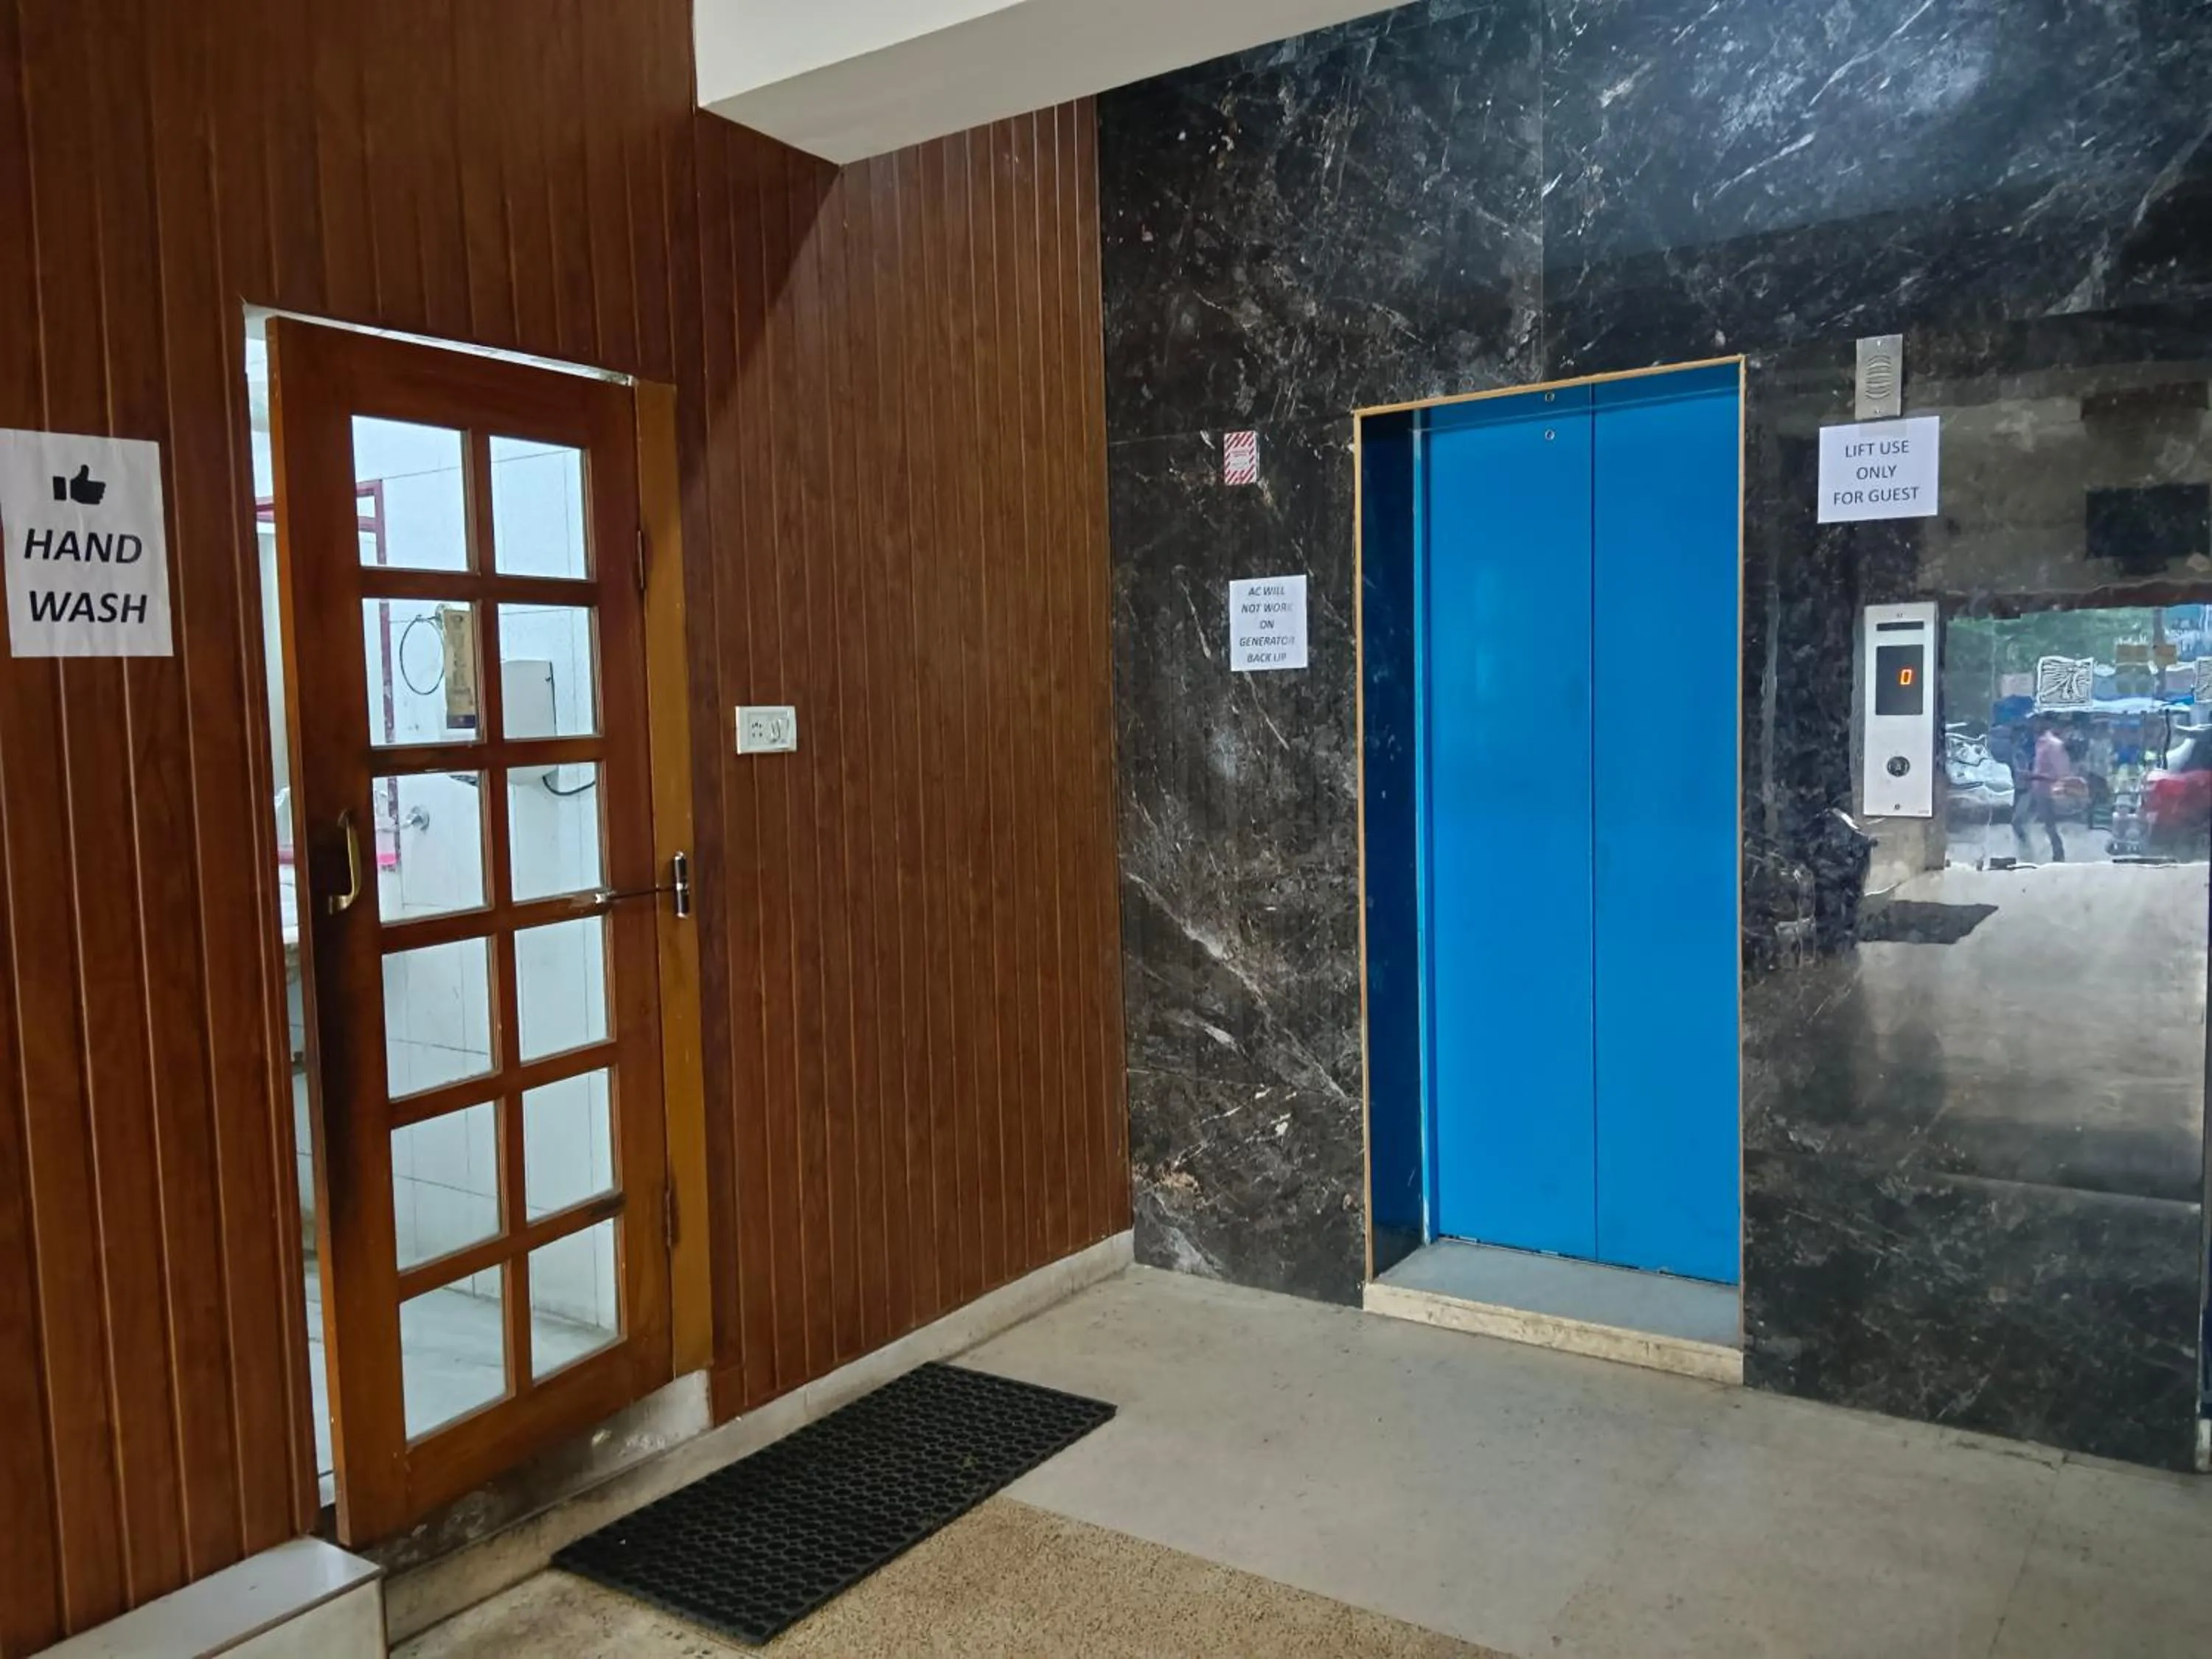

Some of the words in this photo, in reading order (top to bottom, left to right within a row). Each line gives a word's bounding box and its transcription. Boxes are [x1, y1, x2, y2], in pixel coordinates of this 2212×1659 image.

[1845, 442, 1876, 458] LIFT
[1879, 439, 1910, 455] USE
[1856, 465, 1897, 480] ONLY
[1833, 491, 1864, 505] FOR
[1868, 486, 1920, 503] GUEST
[24, 528, 142, 564] HAND
[1248, 586, 1262, 597] AC
[1263, 586, 1285, 596] WILL
[29, 590, 147, 624] WASH
[1241, 603, 1262, 613] NOT
[1259, 619, 1275, 630] ON
[1239, 636, 1295, 647] GENERATOR
[1247, 653, 1272, 663] BACK
[1273, 652, 1287, 661] UP
[1900, 669, 1912, 685] 0
